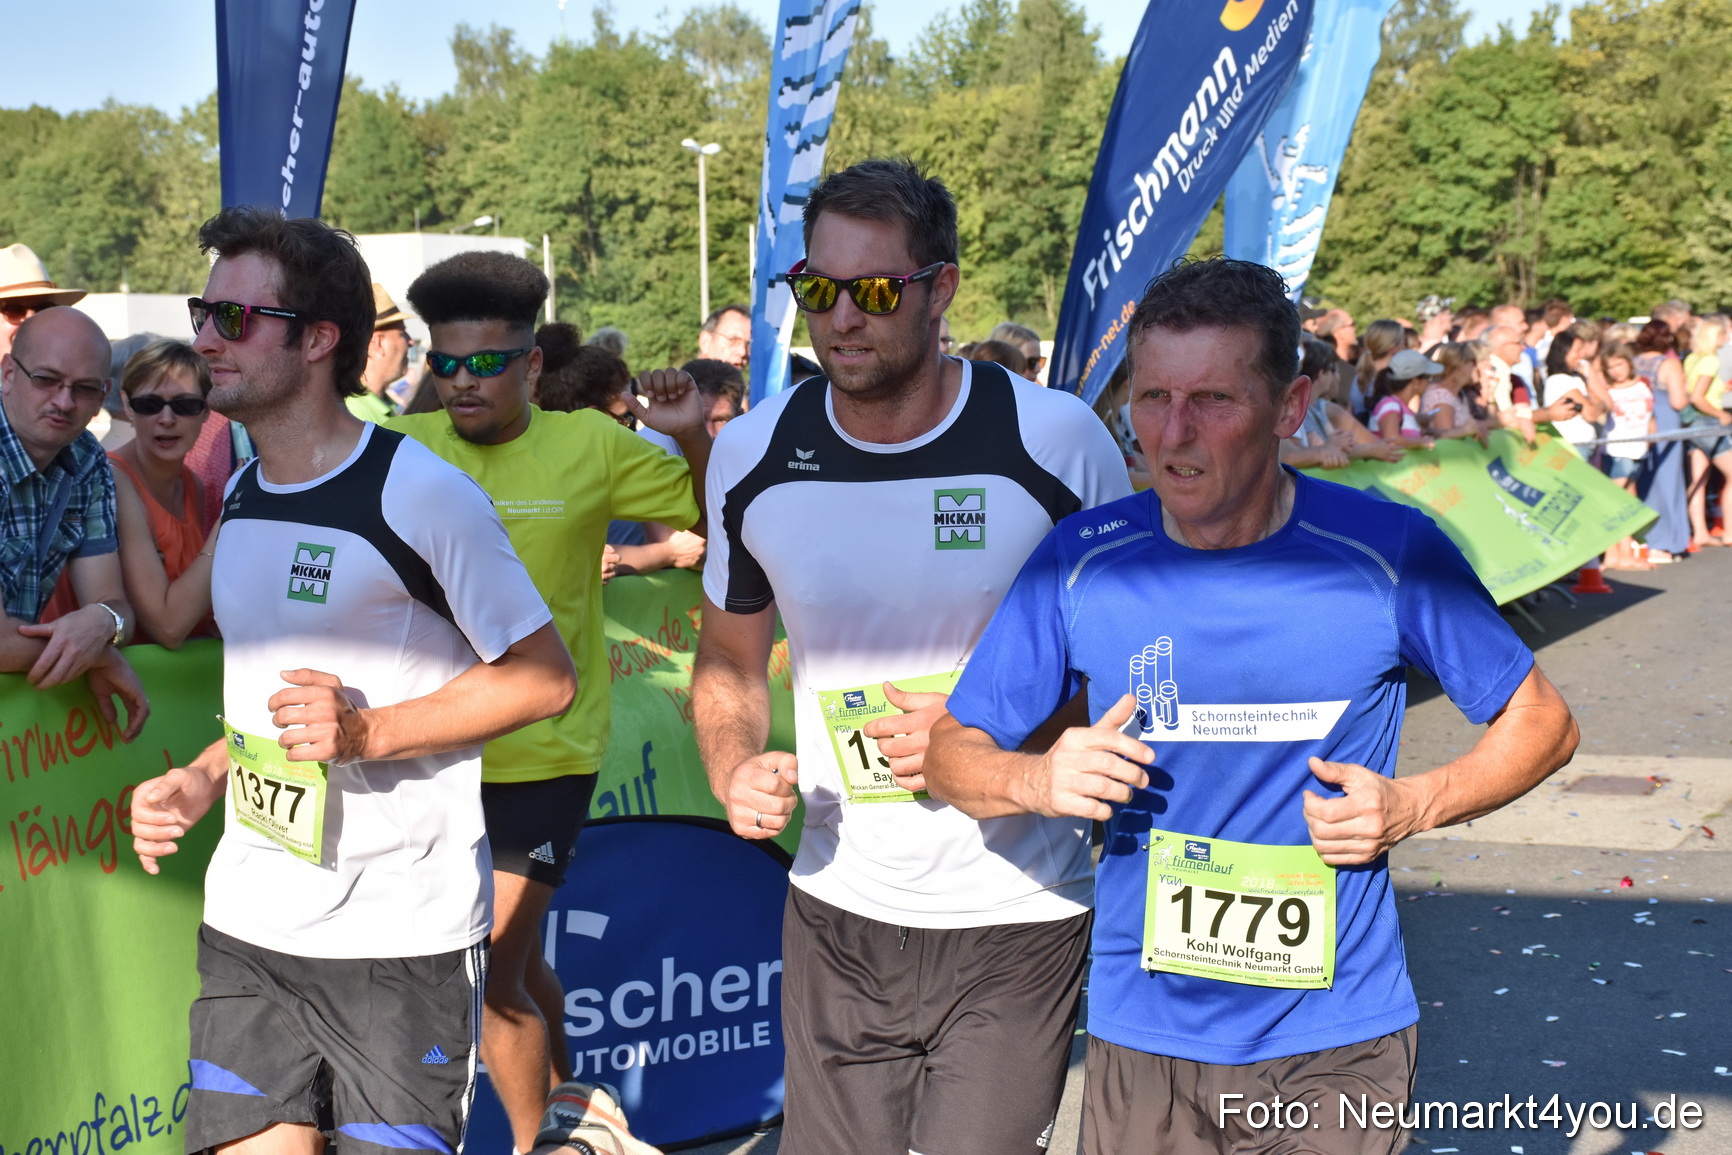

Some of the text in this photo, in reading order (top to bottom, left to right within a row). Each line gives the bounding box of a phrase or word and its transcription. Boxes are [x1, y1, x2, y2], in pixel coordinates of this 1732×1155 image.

[1177, 0, 1299, 193] Druck und Medien
[1082, 45, 1238, 312] Frischmann
[787, 461, 820, 471] erima
[934, 513, 986, 526] MICKAN
[1097, 519, 1128, 536] JAKO
[290, 564, 332, 581] MICKAN
[838, 701, 887, 718] firmenlauf
[1192, 709, 1318, 723] Schornsteintechnik
[1192, 725, 1258, 736] Neumarkt
[236, 765, 306, 823] 1377
[1172, 855, 1234, 875] firmenlauf
[1240, 876, 1276, 889] 2018
[1171, 885, 1310, 947] 1779
[1186, 938, 1291, 965] Kohl Wolfgang
[1153, 947, 1242, 969] Schornsteintechnik
[1244, 961, 1291, 973] Neumarkt
[1294, 965, 1324, 974] GmbH
[563, 957, 783, 1037] scher
[421, 1056, 449, 1064] adidas
